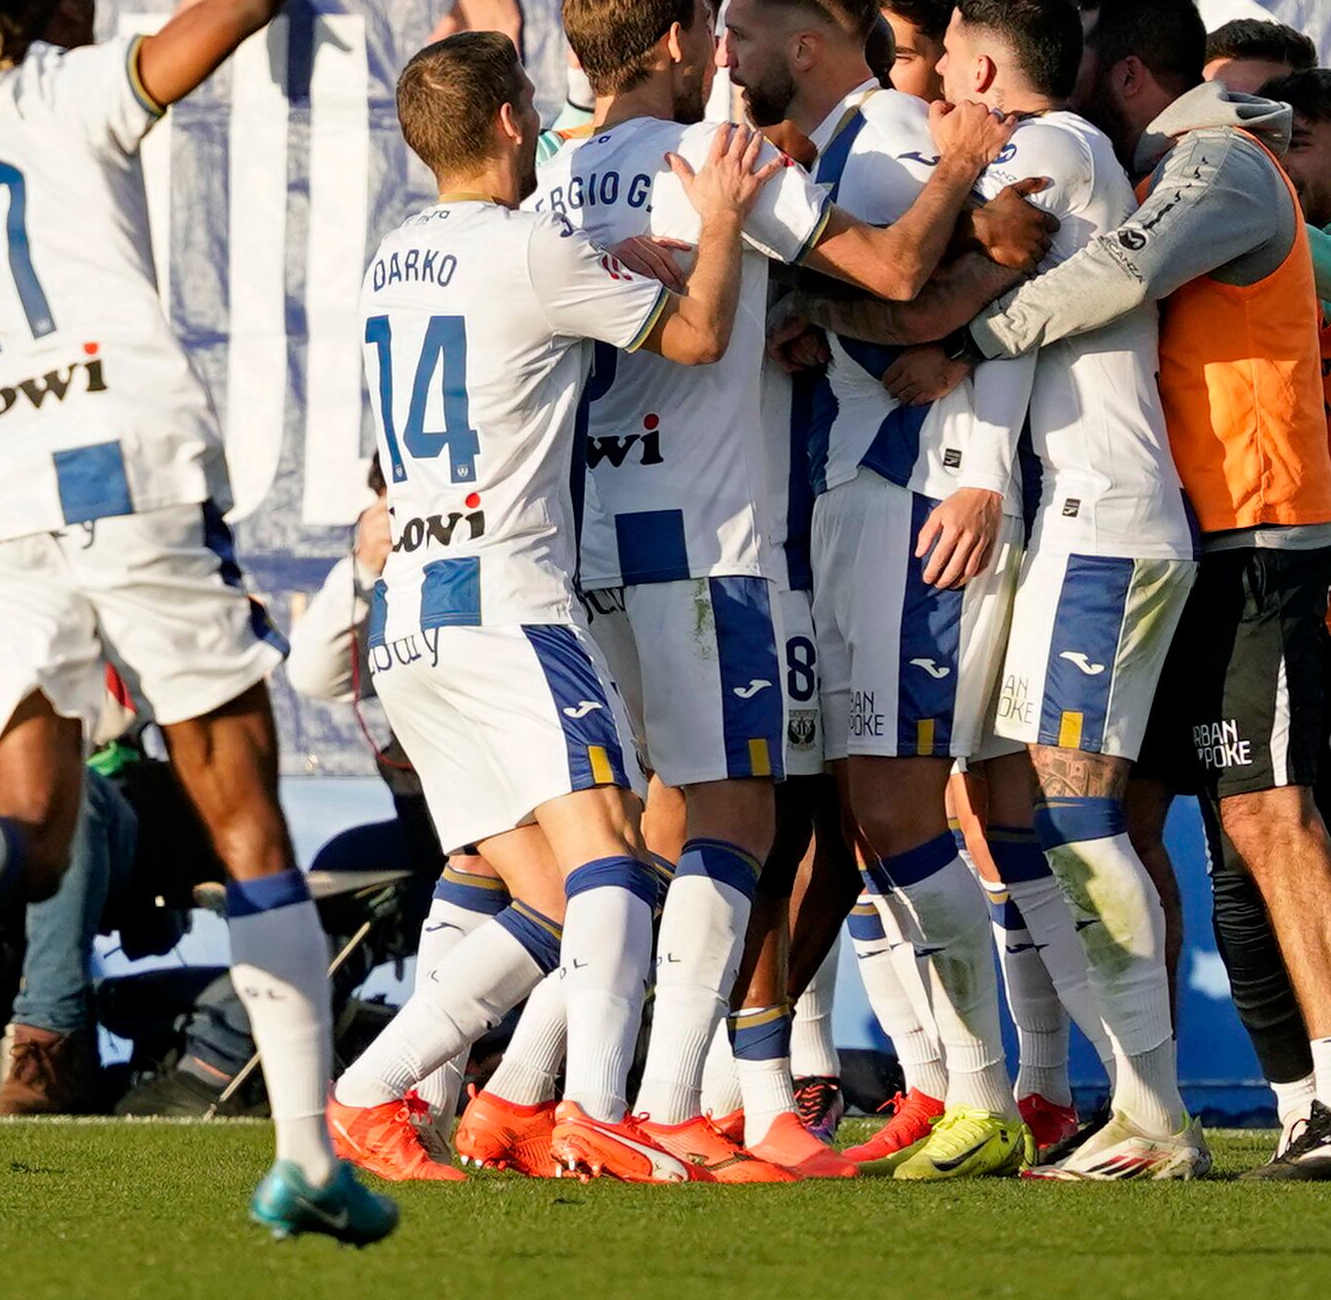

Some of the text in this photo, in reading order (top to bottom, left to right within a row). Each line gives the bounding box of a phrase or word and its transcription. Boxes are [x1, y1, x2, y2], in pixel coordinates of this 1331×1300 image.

[627, 173, 653, 213] G.
[373, 249, 458, 292] DARKO
[365, 314, 481, 483] 14
[1193, 719, 1238, 747] RBAN
[1204, 740, 1253, 769] POKE
